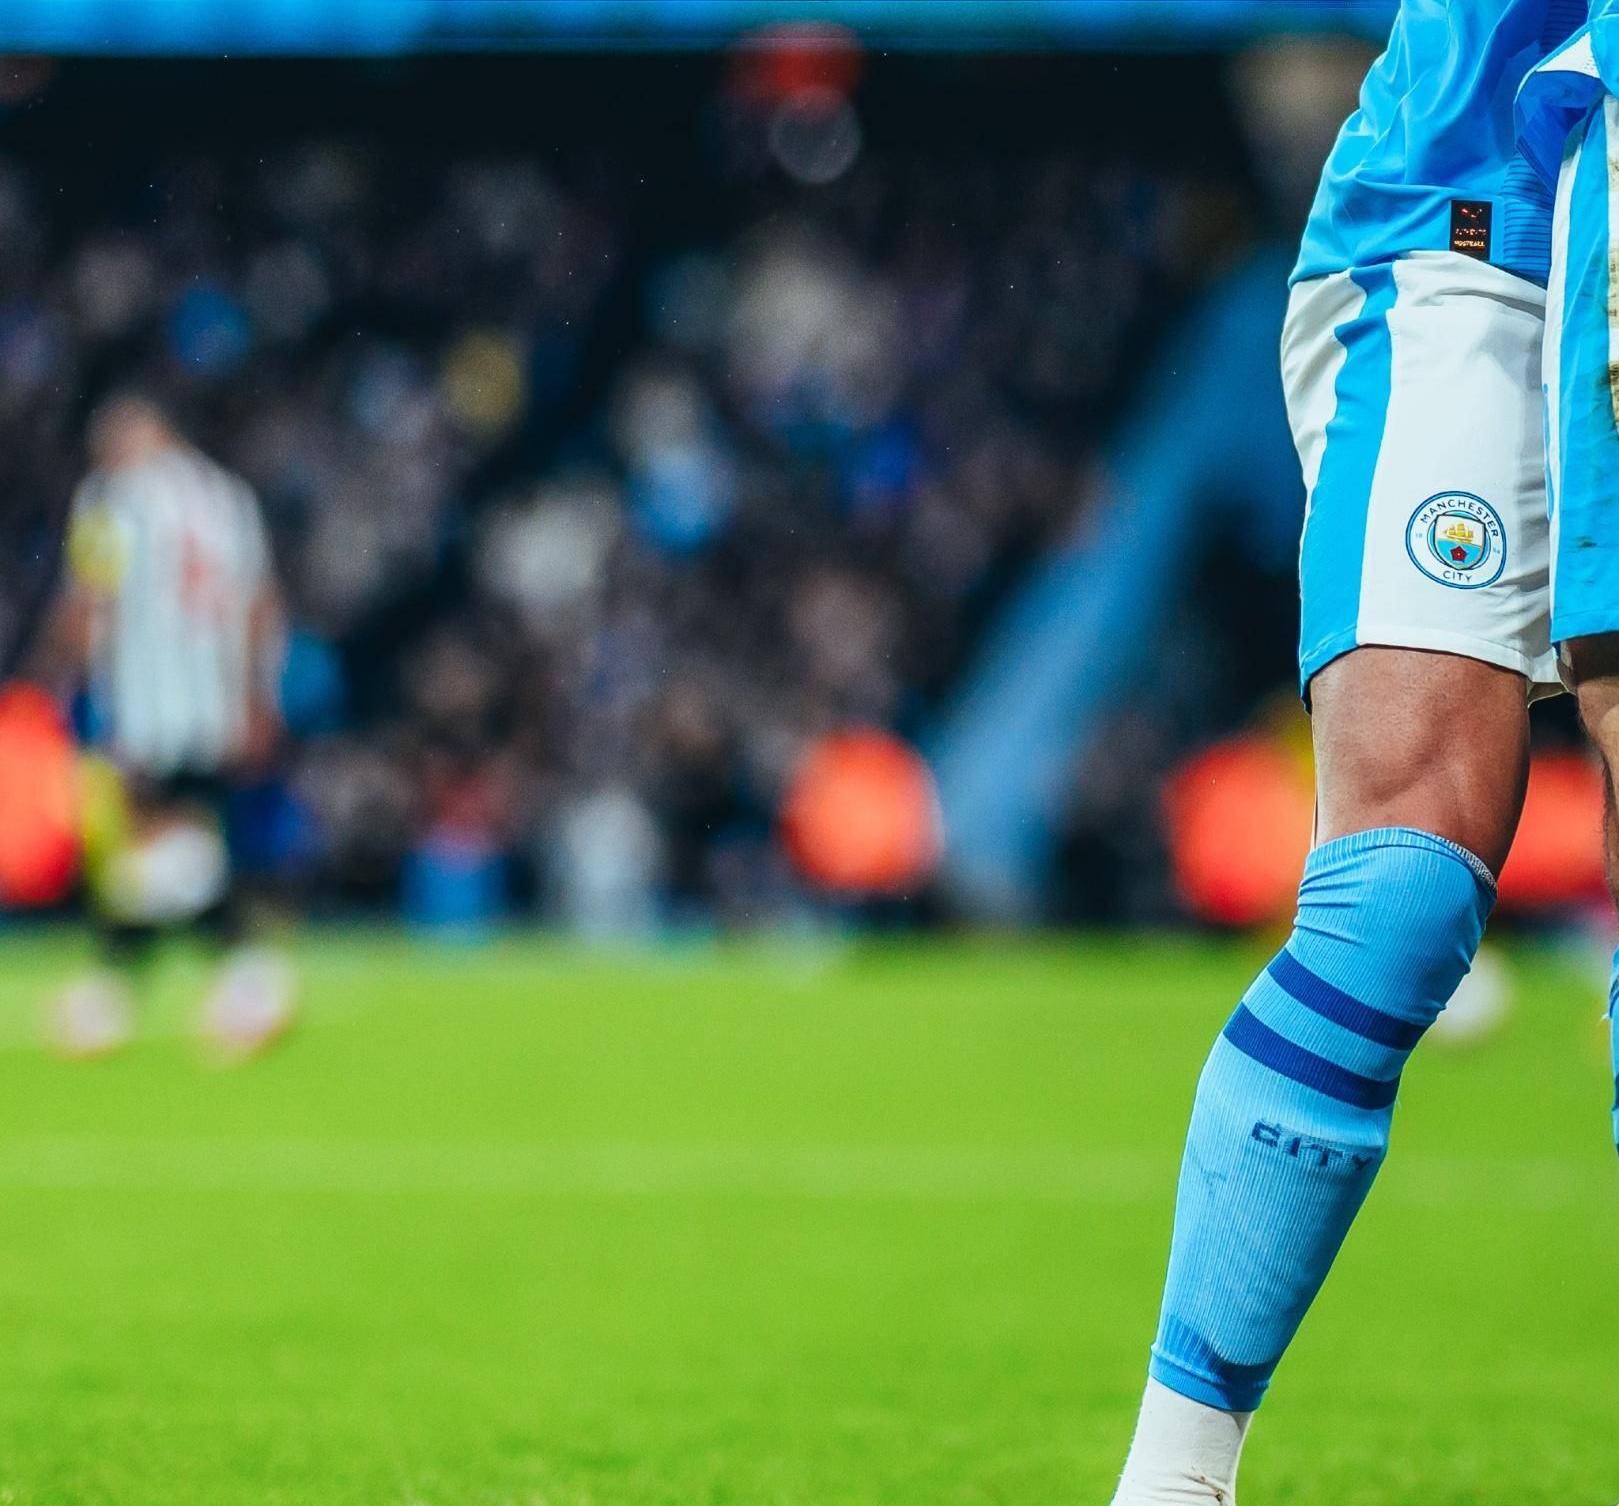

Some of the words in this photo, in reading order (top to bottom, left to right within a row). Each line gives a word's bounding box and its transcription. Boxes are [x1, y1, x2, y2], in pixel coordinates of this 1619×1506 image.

[1420, 499, 1499, 537] MANCHESTER
[1443, 570, 1472, 582] CITY
[1251, 1121, 1374, 1172] CITY
